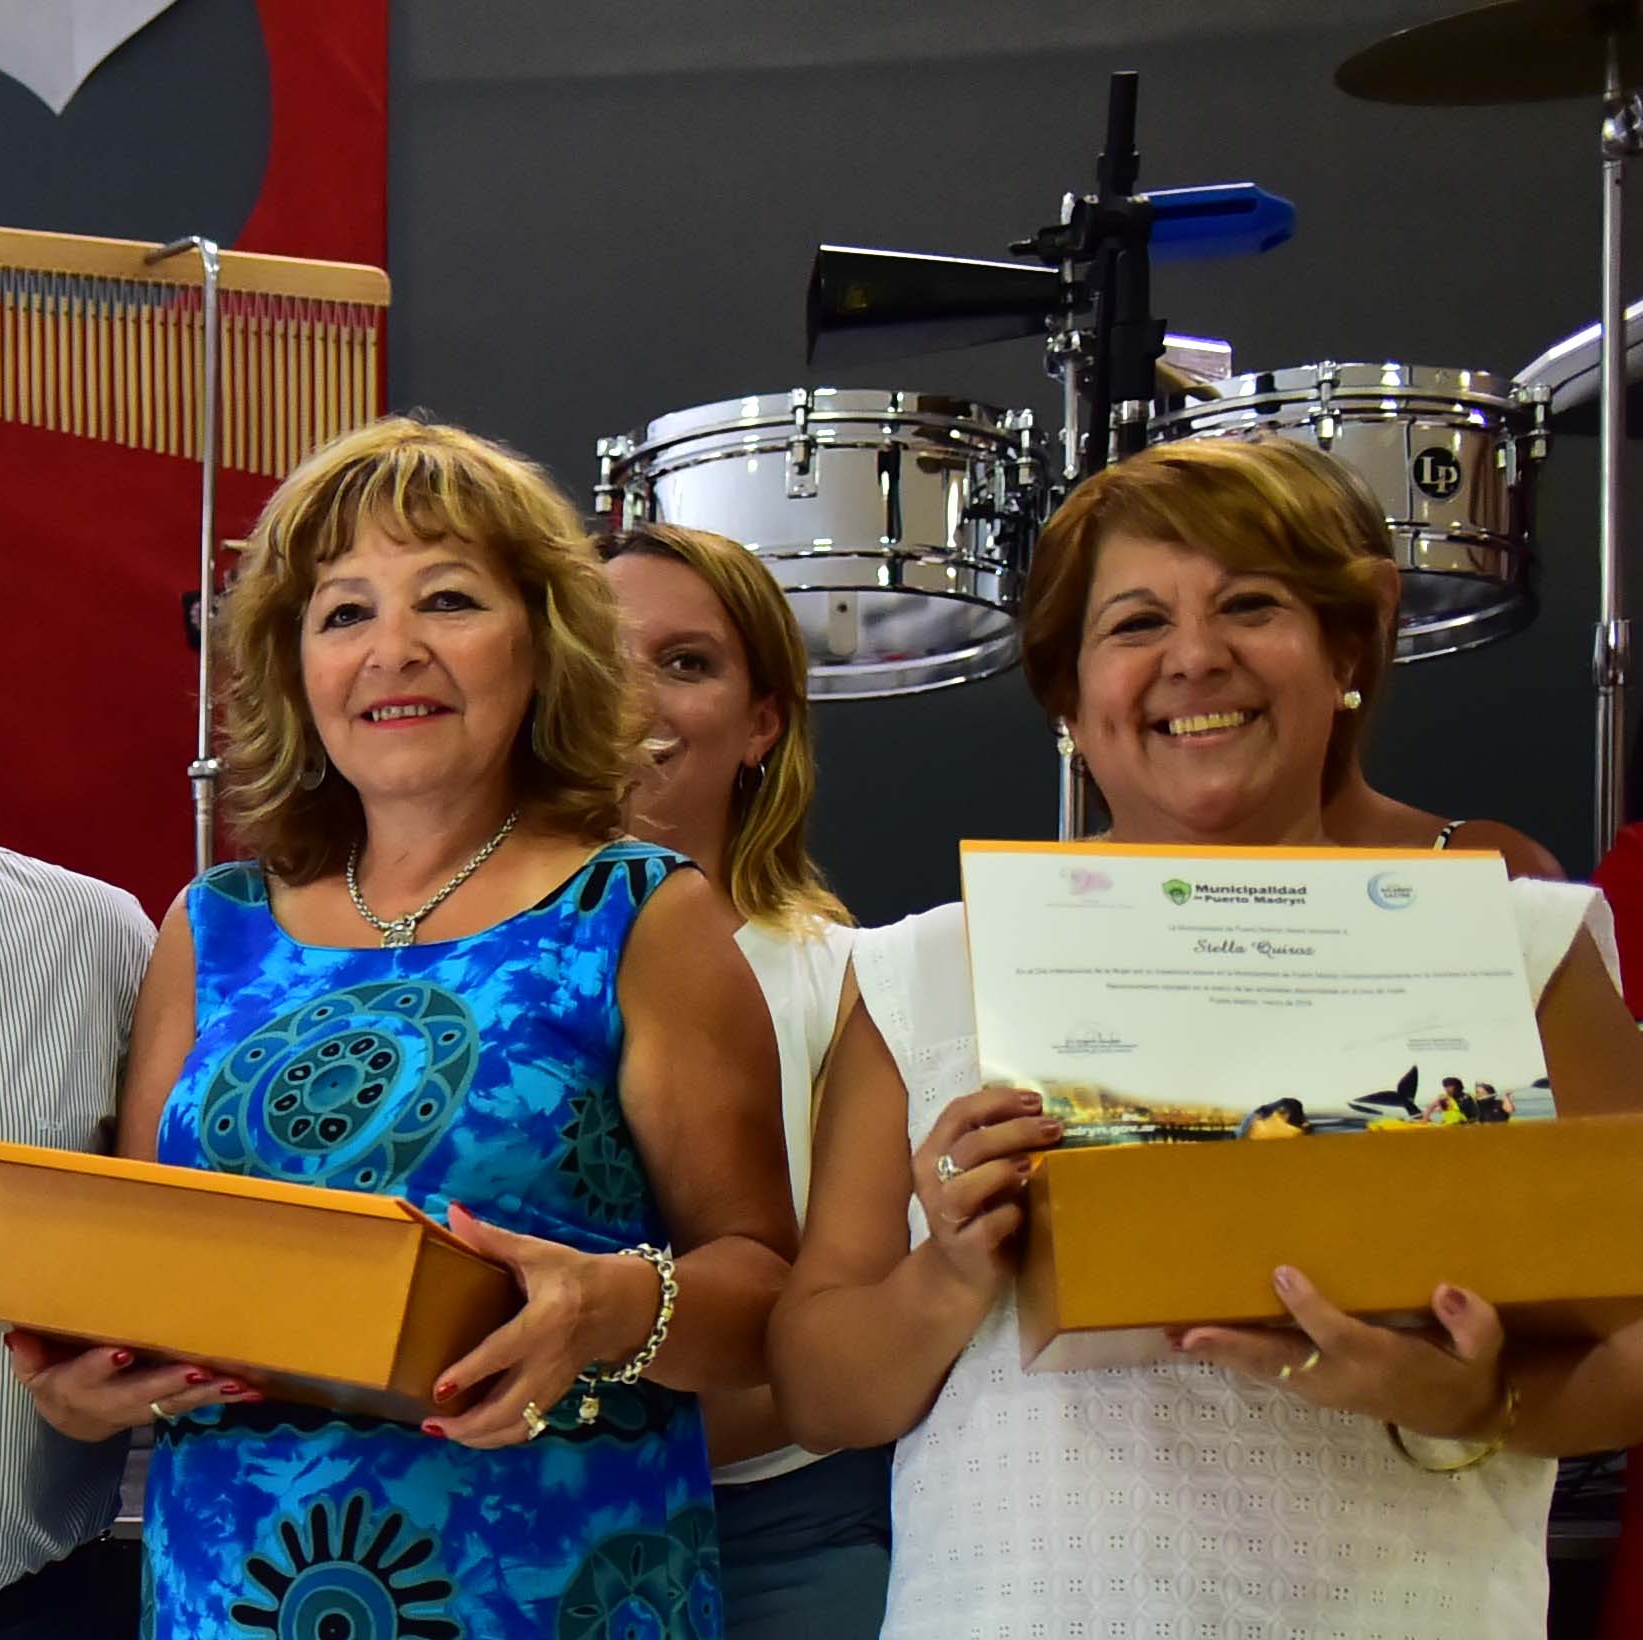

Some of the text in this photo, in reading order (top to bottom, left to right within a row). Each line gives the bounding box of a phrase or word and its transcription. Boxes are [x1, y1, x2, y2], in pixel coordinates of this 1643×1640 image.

[1194, 884, 1307, 897] Municipalidad
[1203, 895, 1250, 905] Puerto
[1254, 896, 1306, 907] Madryn
[1192, 938, 1246, 955] Stella
[1063, 1122, 1157, 1138] adryn.gov.ar
